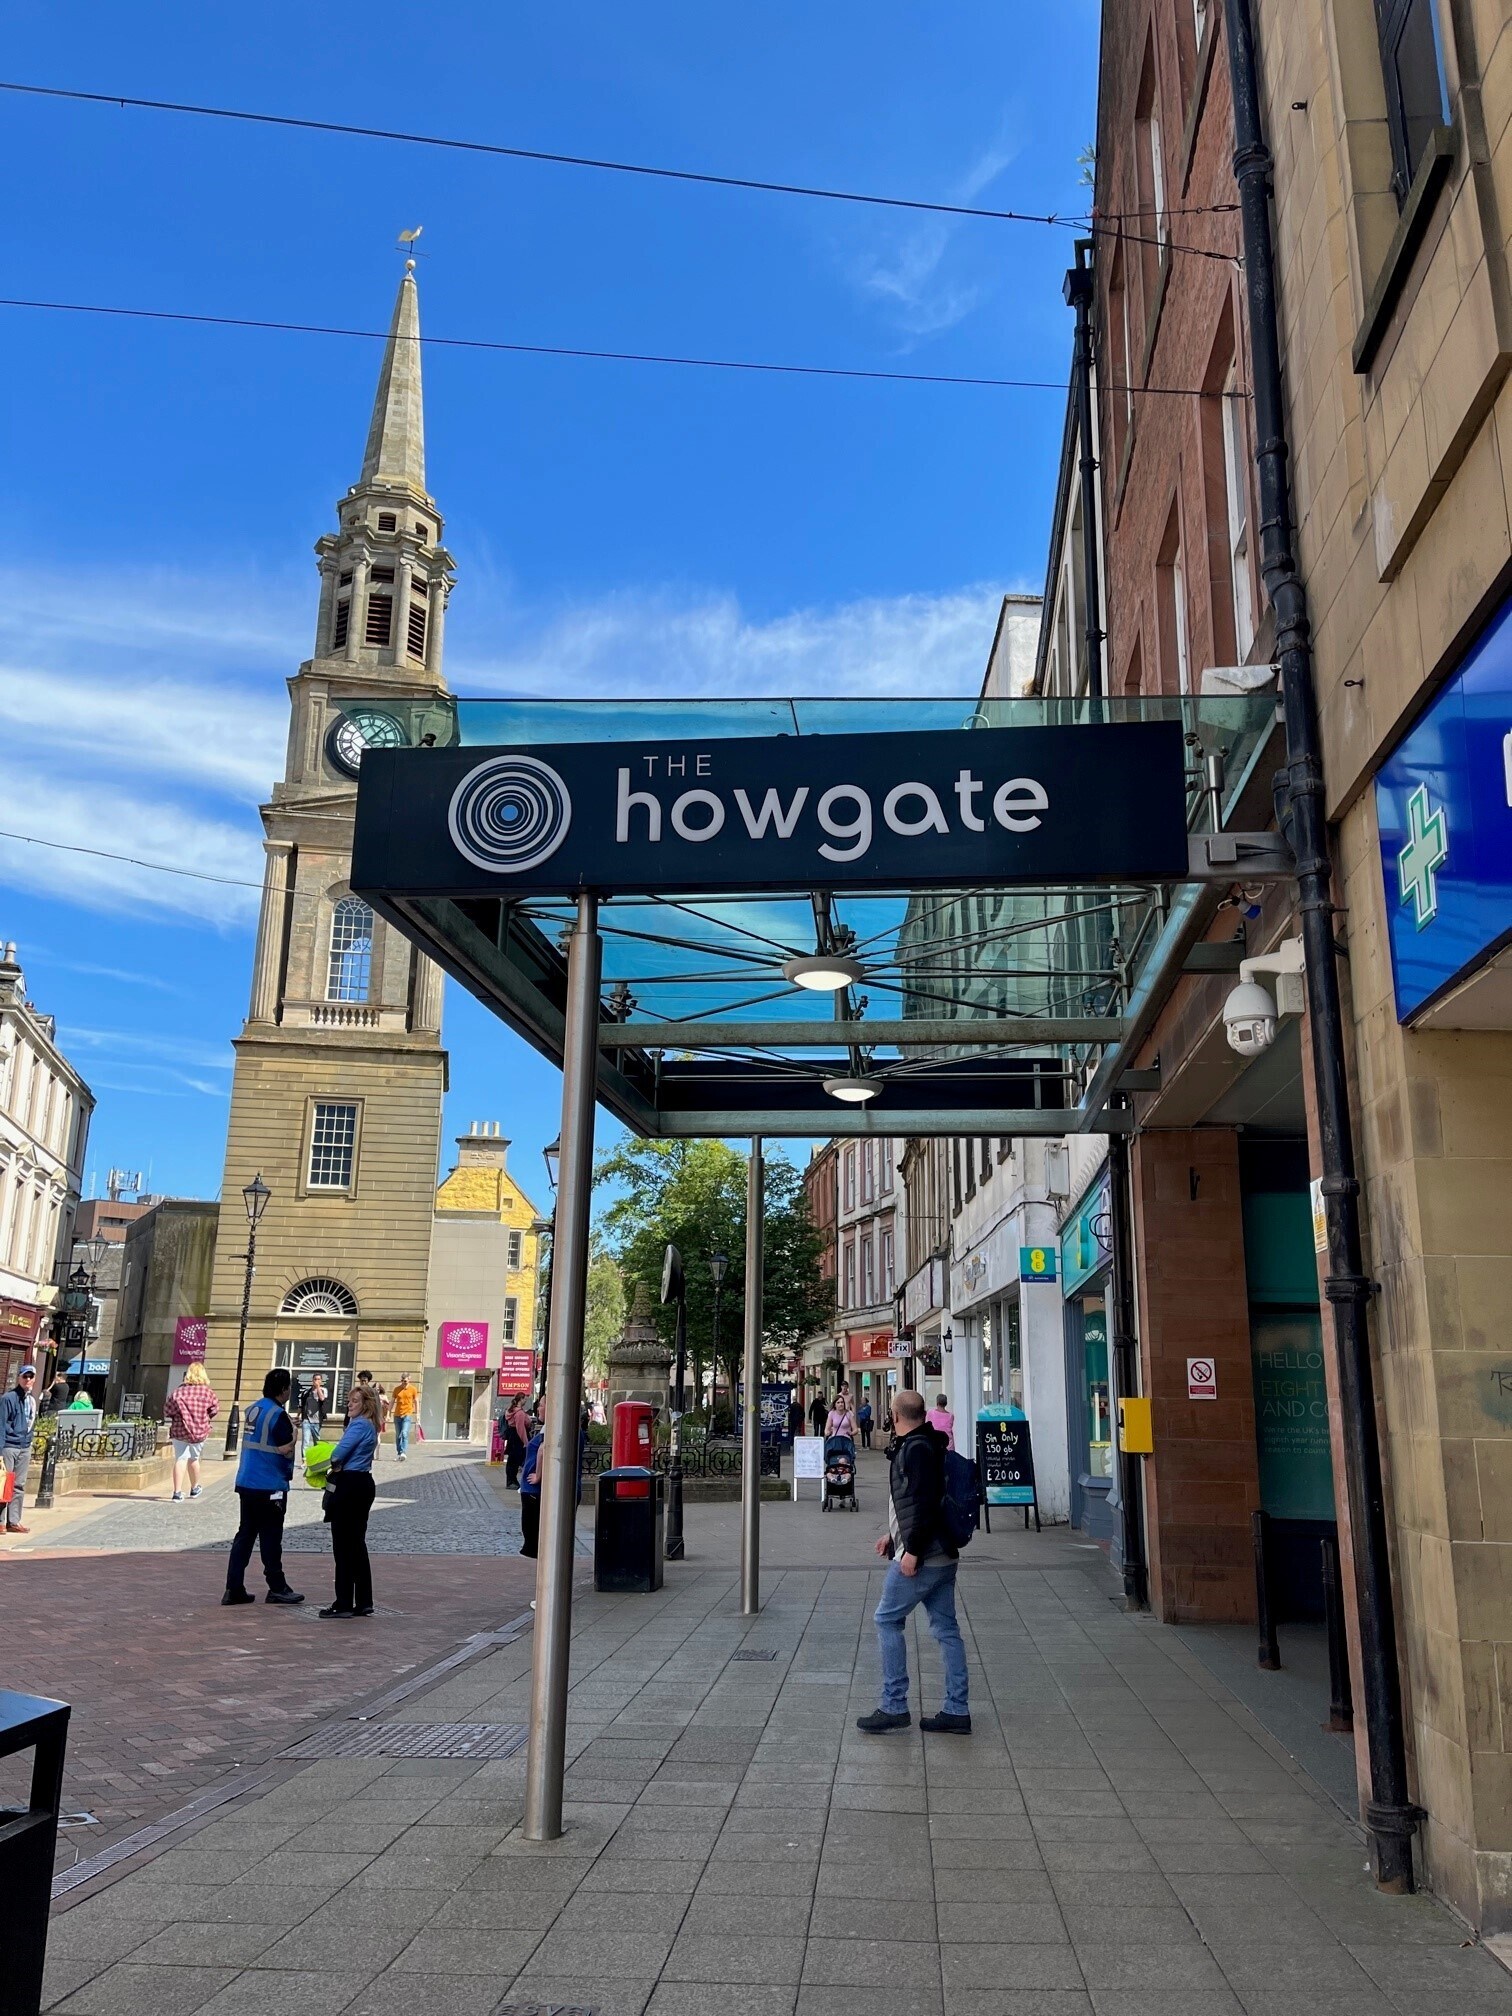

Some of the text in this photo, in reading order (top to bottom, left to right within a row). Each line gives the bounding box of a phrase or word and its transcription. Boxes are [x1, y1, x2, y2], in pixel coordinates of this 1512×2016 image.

[643, 754, 712, 777] THE
[616, 767, 1049, 862] howgate
[1259, 1352, 1323, 1369] HELLO
[1261, 1380, 1322, 1397] EIGHT
[1262, 1400, 1306, 1417] AND
[1001, 1432, 1018, 1444] Only
[986, 1445, 1001, 1453] 150
